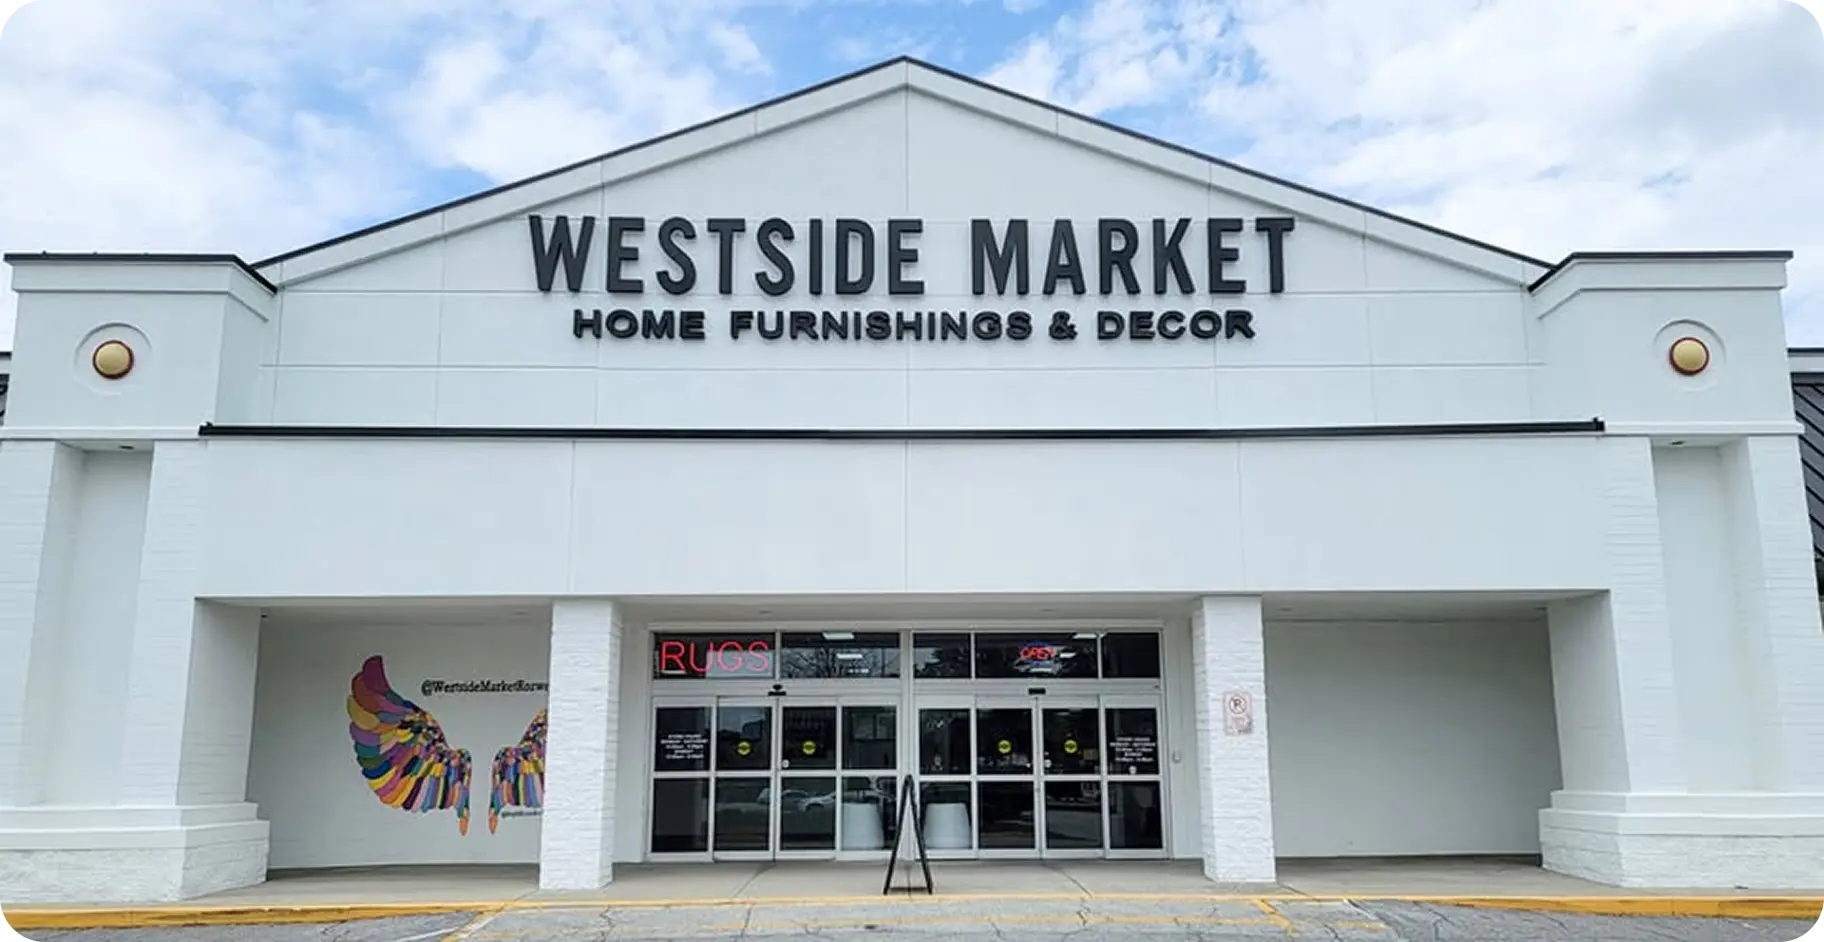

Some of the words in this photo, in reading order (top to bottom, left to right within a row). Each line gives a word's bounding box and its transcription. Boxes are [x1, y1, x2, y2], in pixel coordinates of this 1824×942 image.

[529, 215, 925, 296] WESTSIDE
[971, 217, 1295, 295] MARKET
[573, 309, 706, 340] HOME
[730, 311, 1033, 341] FURNISHINGS
[1048, 311, 1078, 341] &
[1097, 310, 1256, 341] DECOR
[660, 641, 769, 673] RUGS
